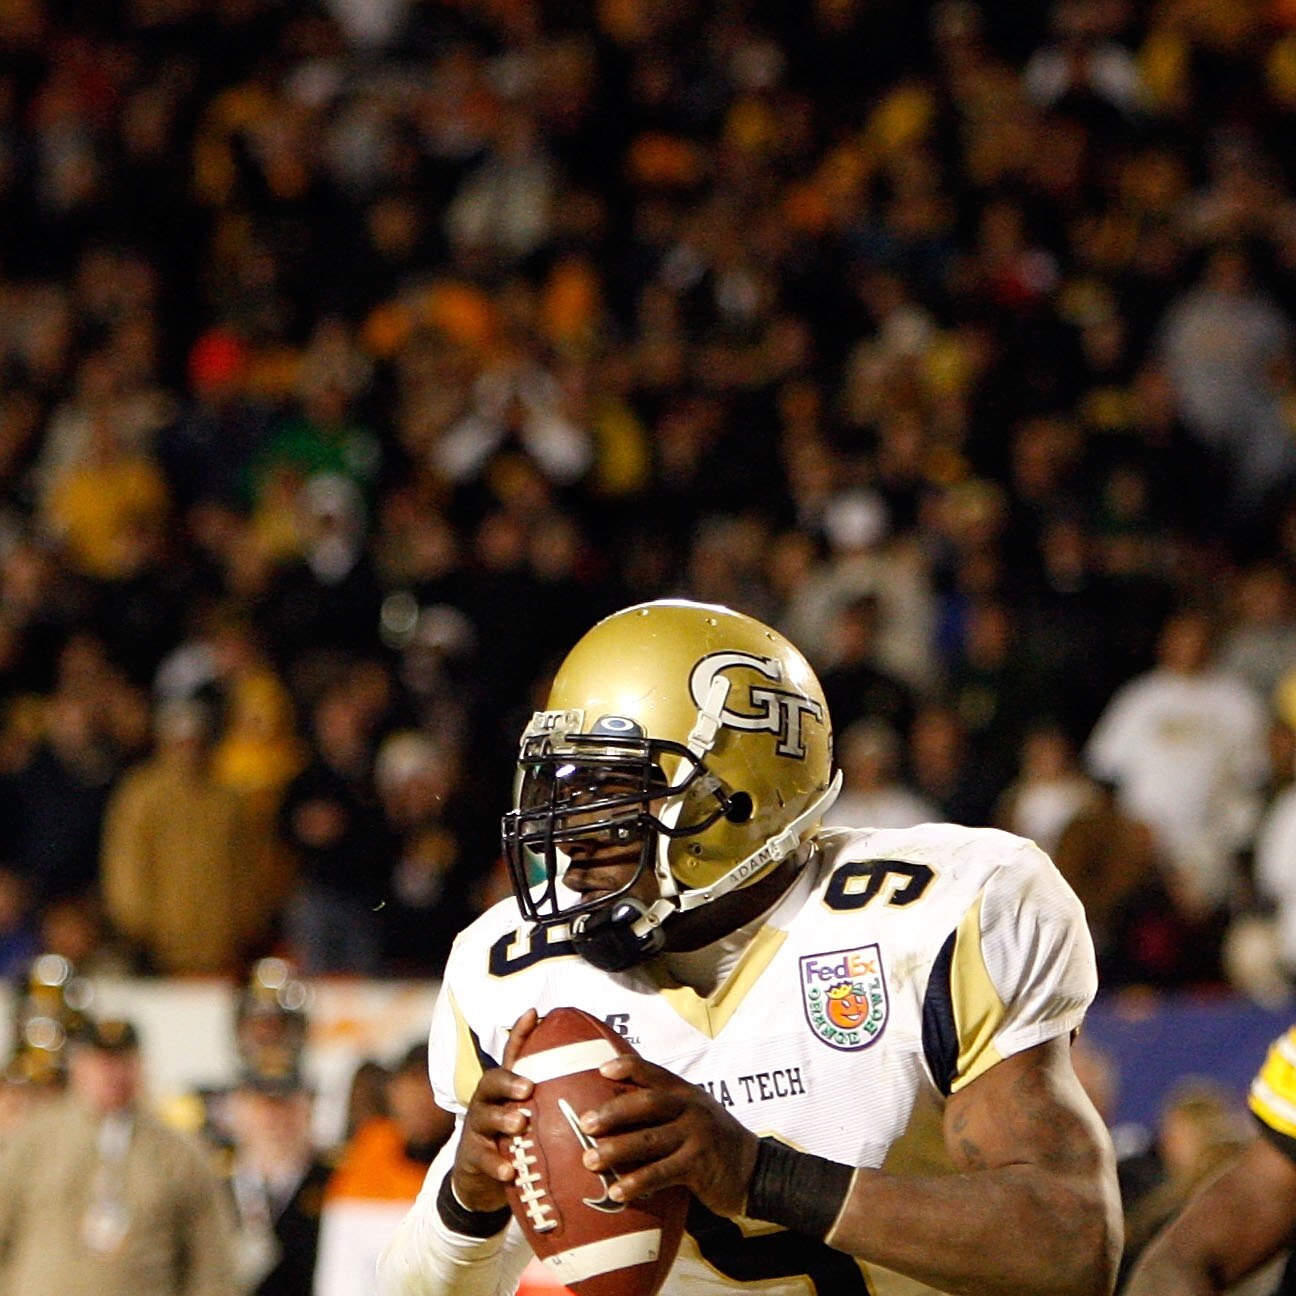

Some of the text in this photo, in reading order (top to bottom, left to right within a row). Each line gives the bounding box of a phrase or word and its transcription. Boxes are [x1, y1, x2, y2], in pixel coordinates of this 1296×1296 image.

[688, 650, 824, 760] GT
[821, 858, 939, 913] 9
[806, 954, 877, 984] FedEx
[807, 977, 884, 1046] ORANGE BOWL
[738, 1067, 806, 1103] TECH
